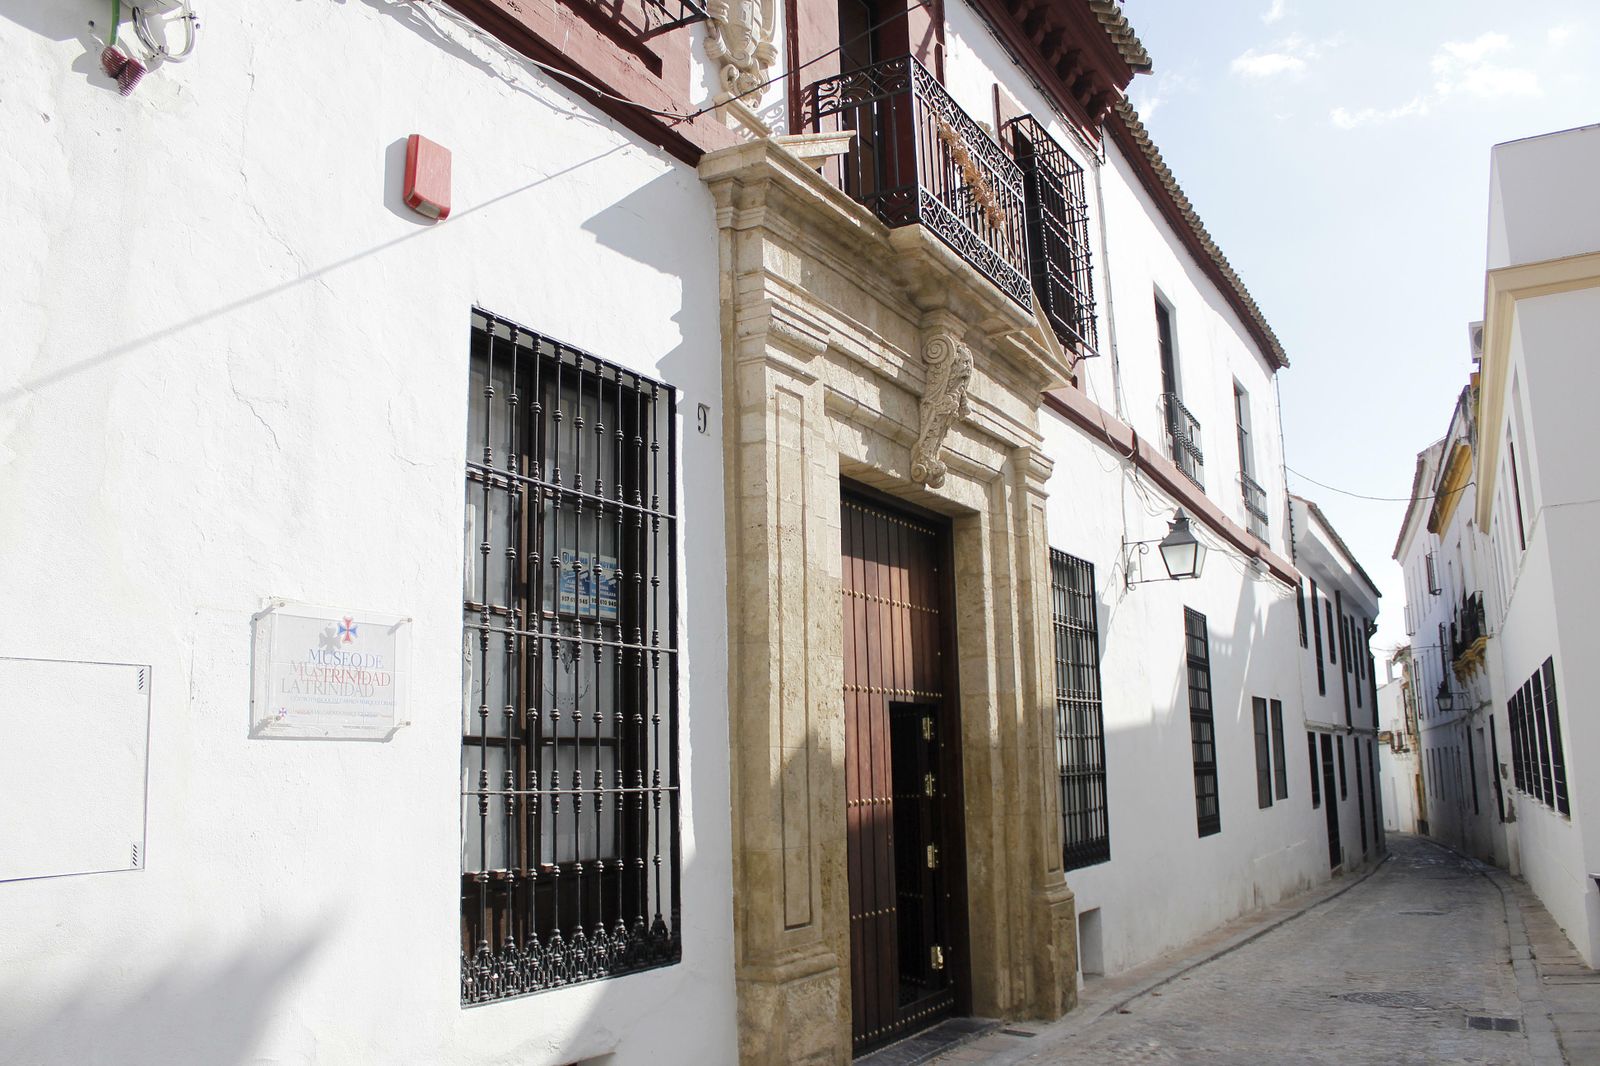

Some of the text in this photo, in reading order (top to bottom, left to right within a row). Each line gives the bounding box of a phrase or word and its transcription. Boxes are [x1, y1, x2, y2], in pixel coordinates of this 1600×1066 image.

[308, 648, 384, 669] MUSEO DE
[320, 667, 392, 687] TRINIDAD
